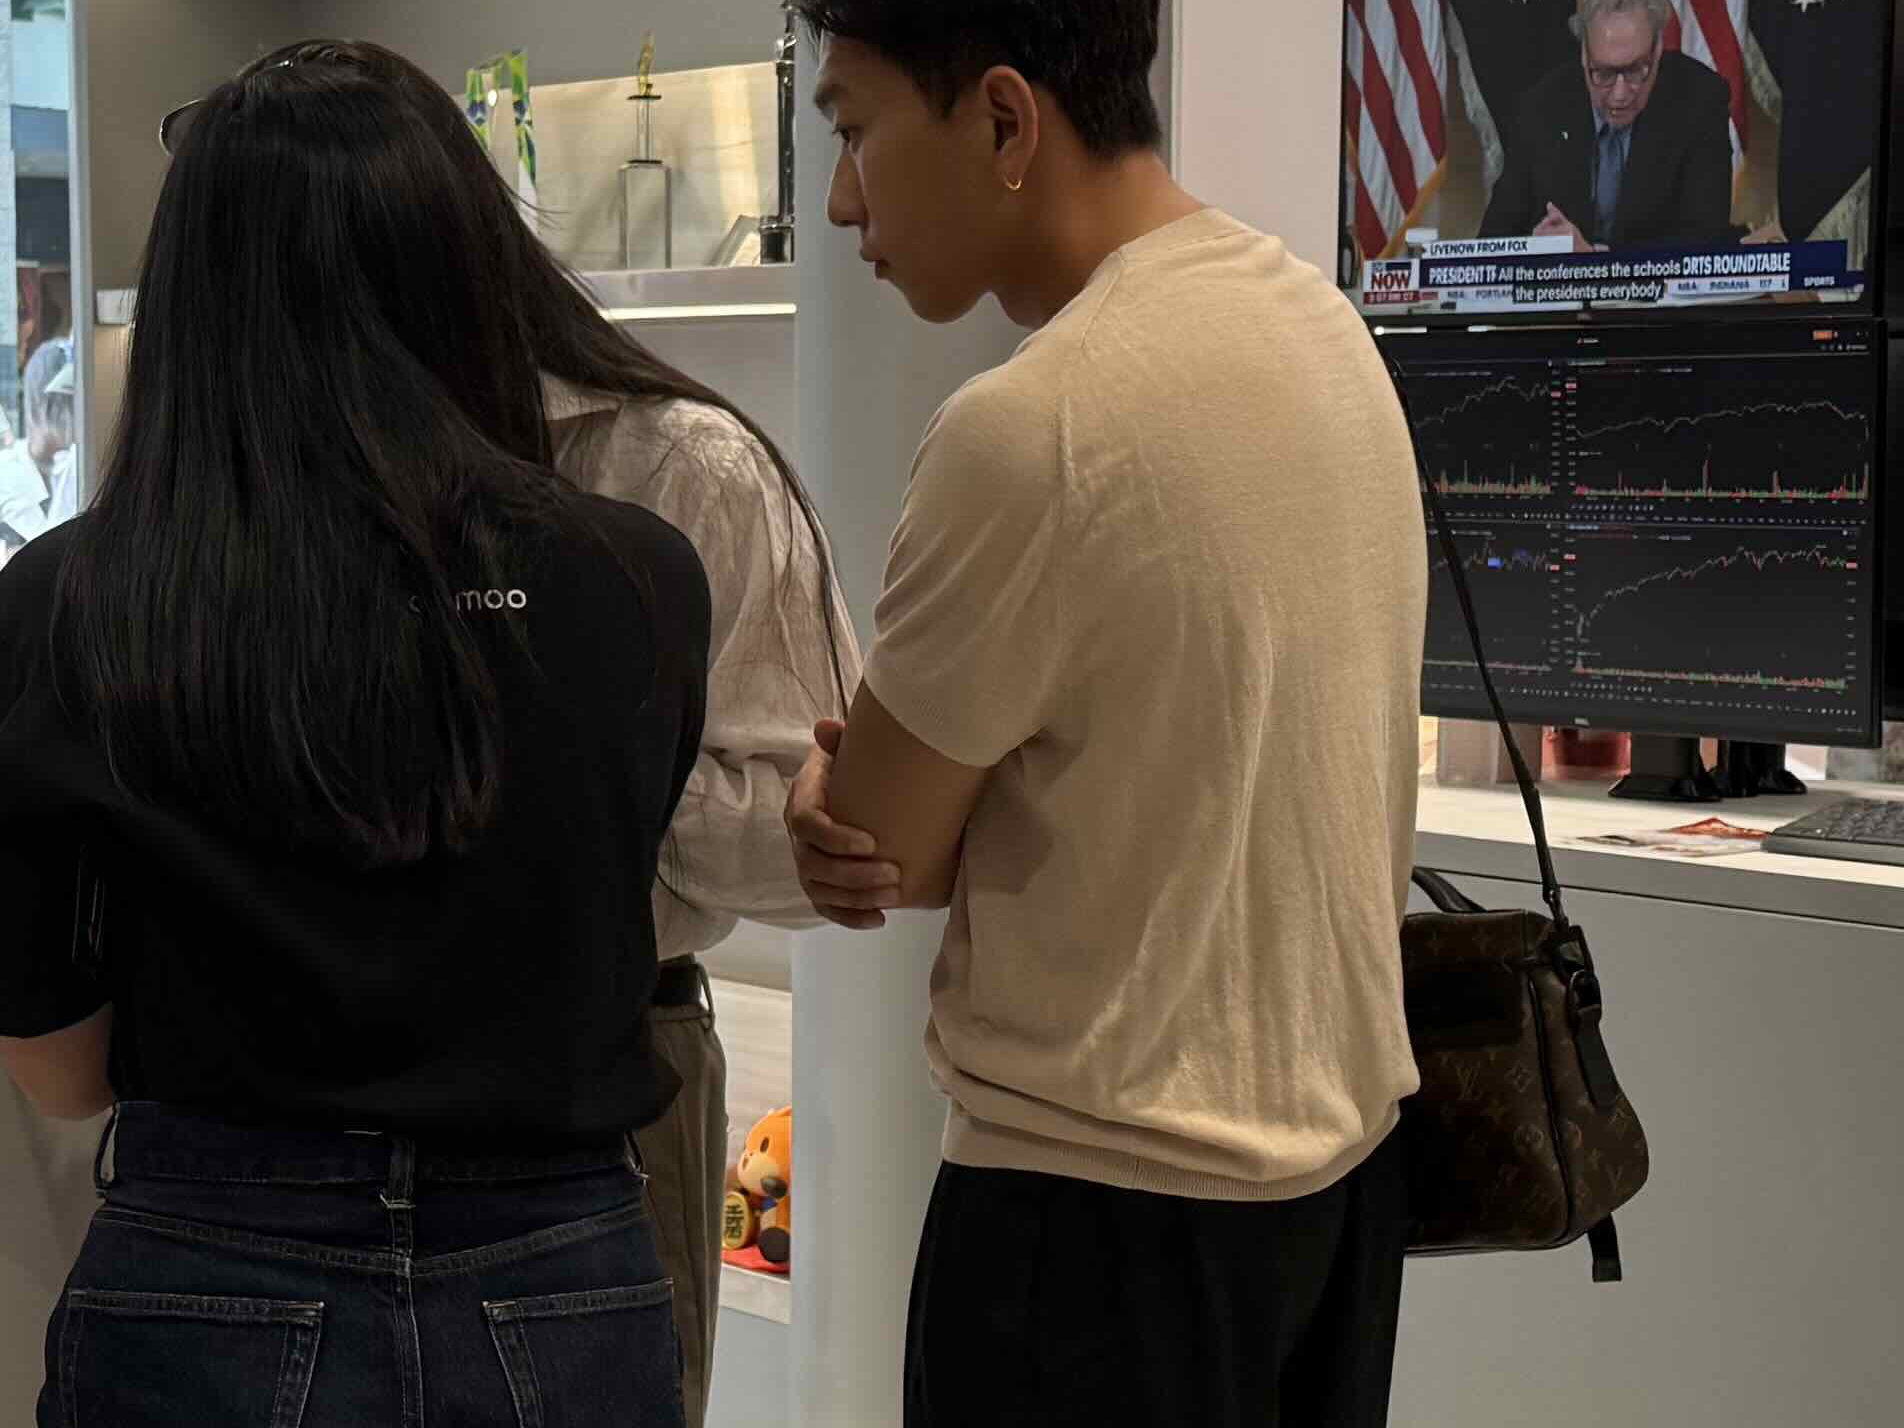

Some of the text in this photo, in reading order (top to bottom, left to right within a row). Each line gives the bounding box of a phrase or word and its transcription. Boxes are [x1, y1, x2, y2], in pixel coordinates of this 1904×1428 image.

[1477, 242, 1506, 254] FROM
[1508, 240, 1528, 252] FOX
[1499, 260, 1681, 282] All the conferences the schools
[1713, 252, 1791, 273] ROUNDTABLE
[1371, 271, 1412, 291] NOW
[1429, 266, 1485, 285] PRESIDENT
[1516, 281, 1663, 305] the presidents everybody
